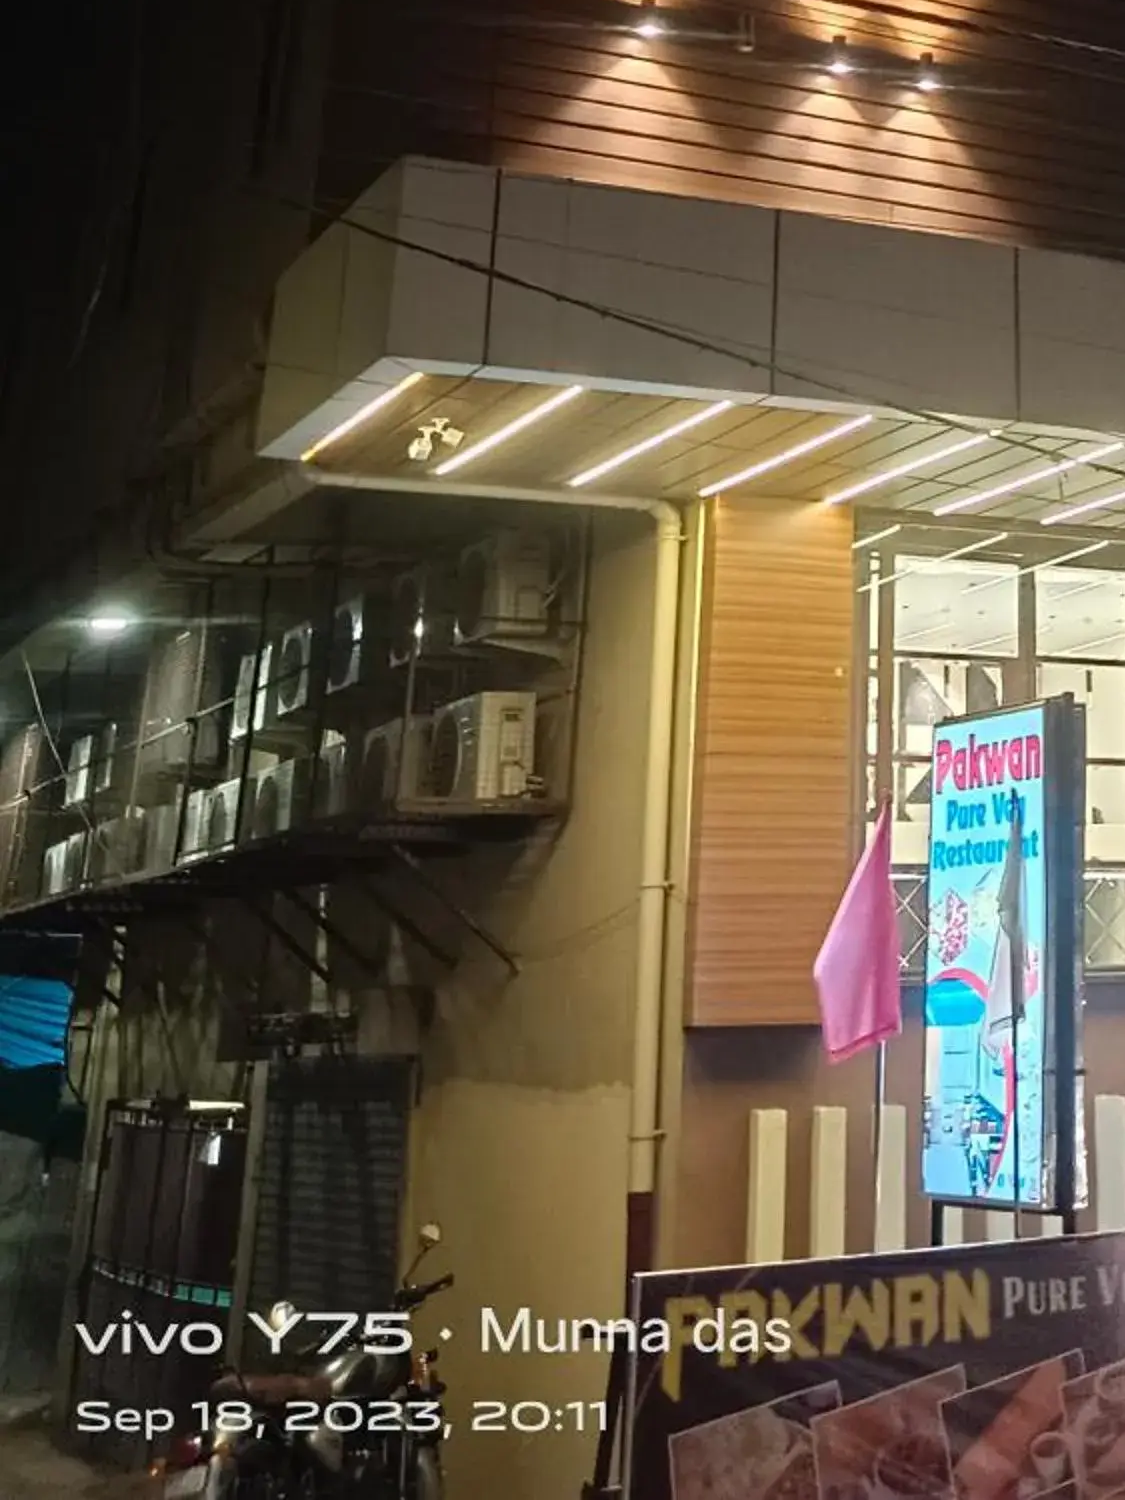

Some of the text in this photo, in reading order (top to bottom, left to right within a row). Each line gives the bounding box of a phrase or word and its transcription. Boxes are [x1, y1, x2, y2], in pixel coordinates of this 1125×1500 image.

[935, 733, 1041, 795] Pakwan
[946, 799, 986, 832] Pure
[933, 829, 1038, 870] Restaurt
